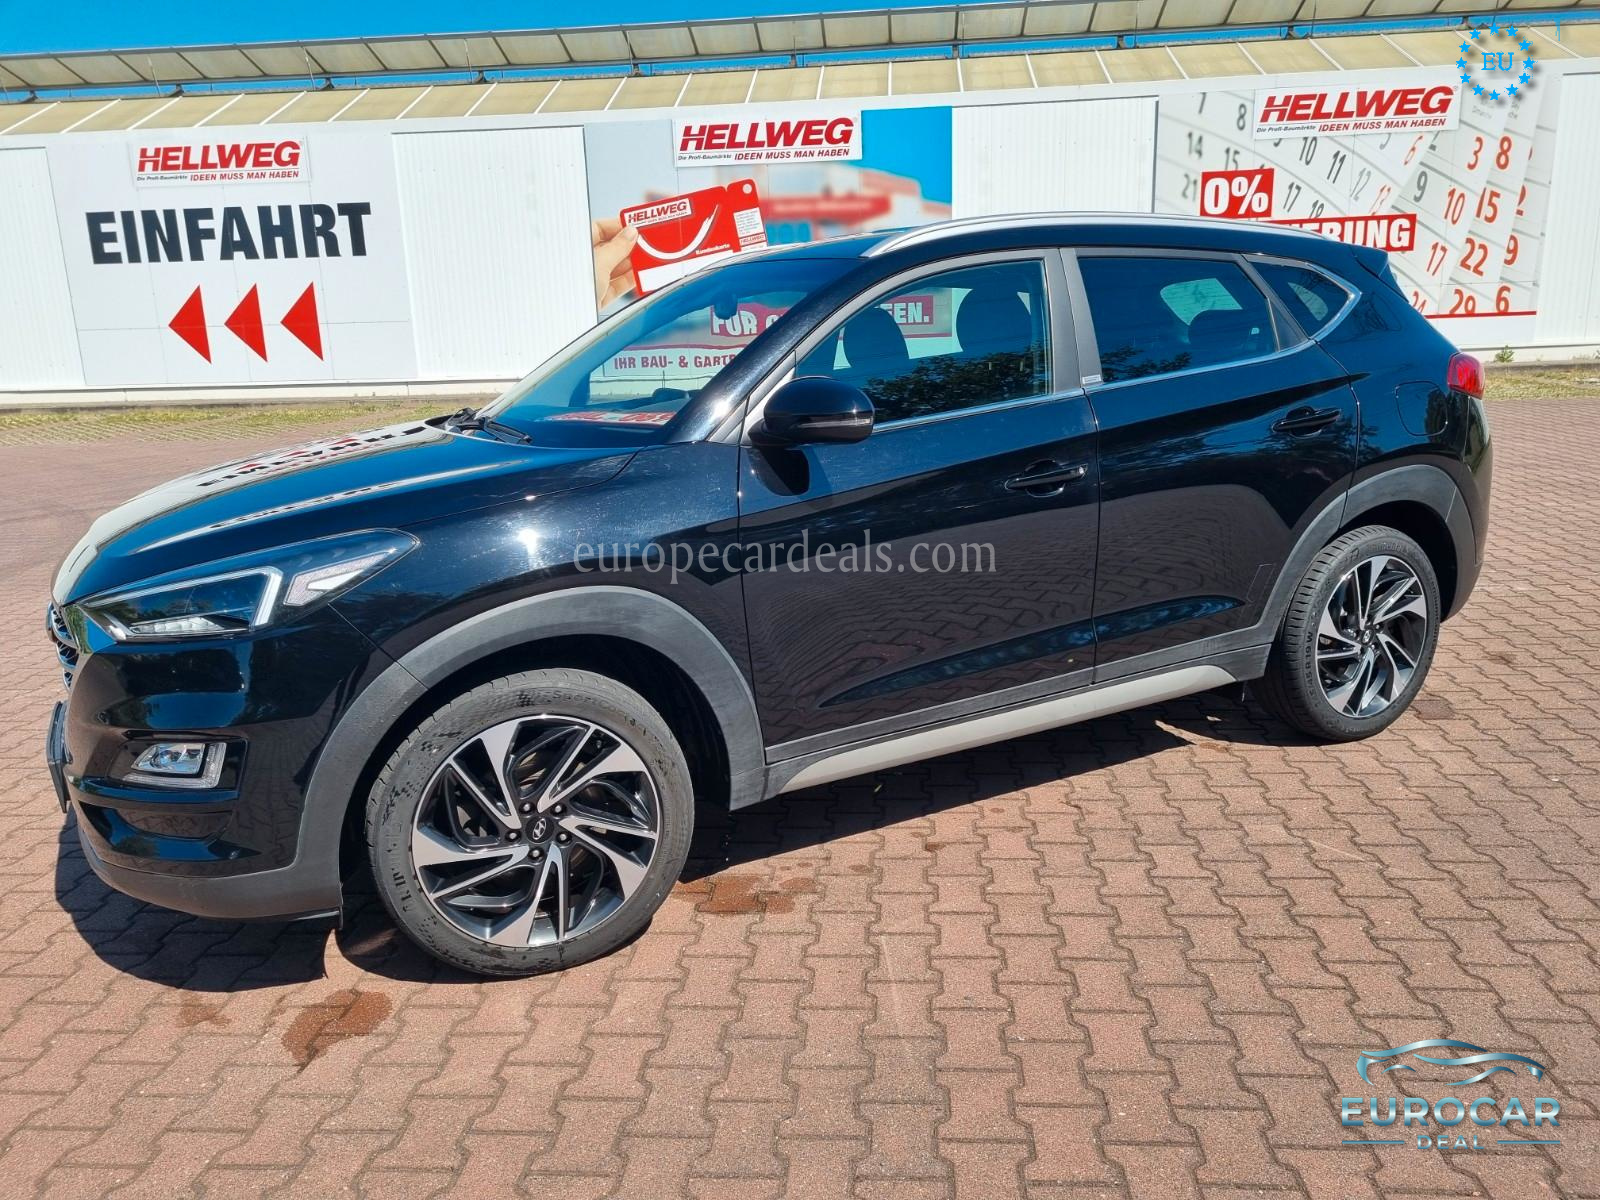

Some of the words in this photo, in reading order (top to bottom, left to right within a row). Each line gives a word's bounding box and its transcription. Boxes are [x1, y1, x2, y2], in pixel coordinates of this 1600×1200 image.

[1236, 103, 1247, 131] 8
[1260, 86, 1454, 123] HELLWEG
[679, 117, 854, 151] HELLWEG
[1318, 123, 1349, 132] IDEEN
[1352, 121, 1381, 131] MUSS
[1384, 120, 1408, 129] MAN
[1410, 118, 1446, 127] HABEN
[138, 140, 301, 172] HELLWEG
[734, 152, 763, 161] IDEEN
[765, 151, 792, 160] MUSS
[794, 150, 815, 158] MAN
[817, 148, 850, 157] HABEN
[1187, 132, 1203, 159] 14
[1299, 136, 1317, 165] 10
[1403, 135, 1423, 165] 6
[1467, 136, 1483, 170] 3
[1496, 136, 1512, 170] 8
[190, 173, 217, 182] IDEEN
[219, 172, 244, 180] MUSS
[246, 171, 266, 179] MAN
[268, 170, 299, 178] HABEN
[1326, 150, 1346, 184] 11
[1182, 173, 1197, 202] 21
[1204, 174, 1269, 215] 0%
[1283, 182, 1301, 213] 17
[1413, 170, 1428, 203] 9
[628, 201, 688, 224] HELLWEG
[1444, 187, 1466, 225] 10
[1475, 187, 1501, 224] 15
[85, 202, 372, 265] EINFAHRT
[1426, 241, 1448, 276] 17
[1459, 237, 1489, 277] 22
[1503, 234, 1519, 266] 9
[1496, 285, 1511, 314] 6
[614, 356, 636, 370] IHR
[641, 355, 673, 368] BAU-
[678, 355, 689, 368] &
